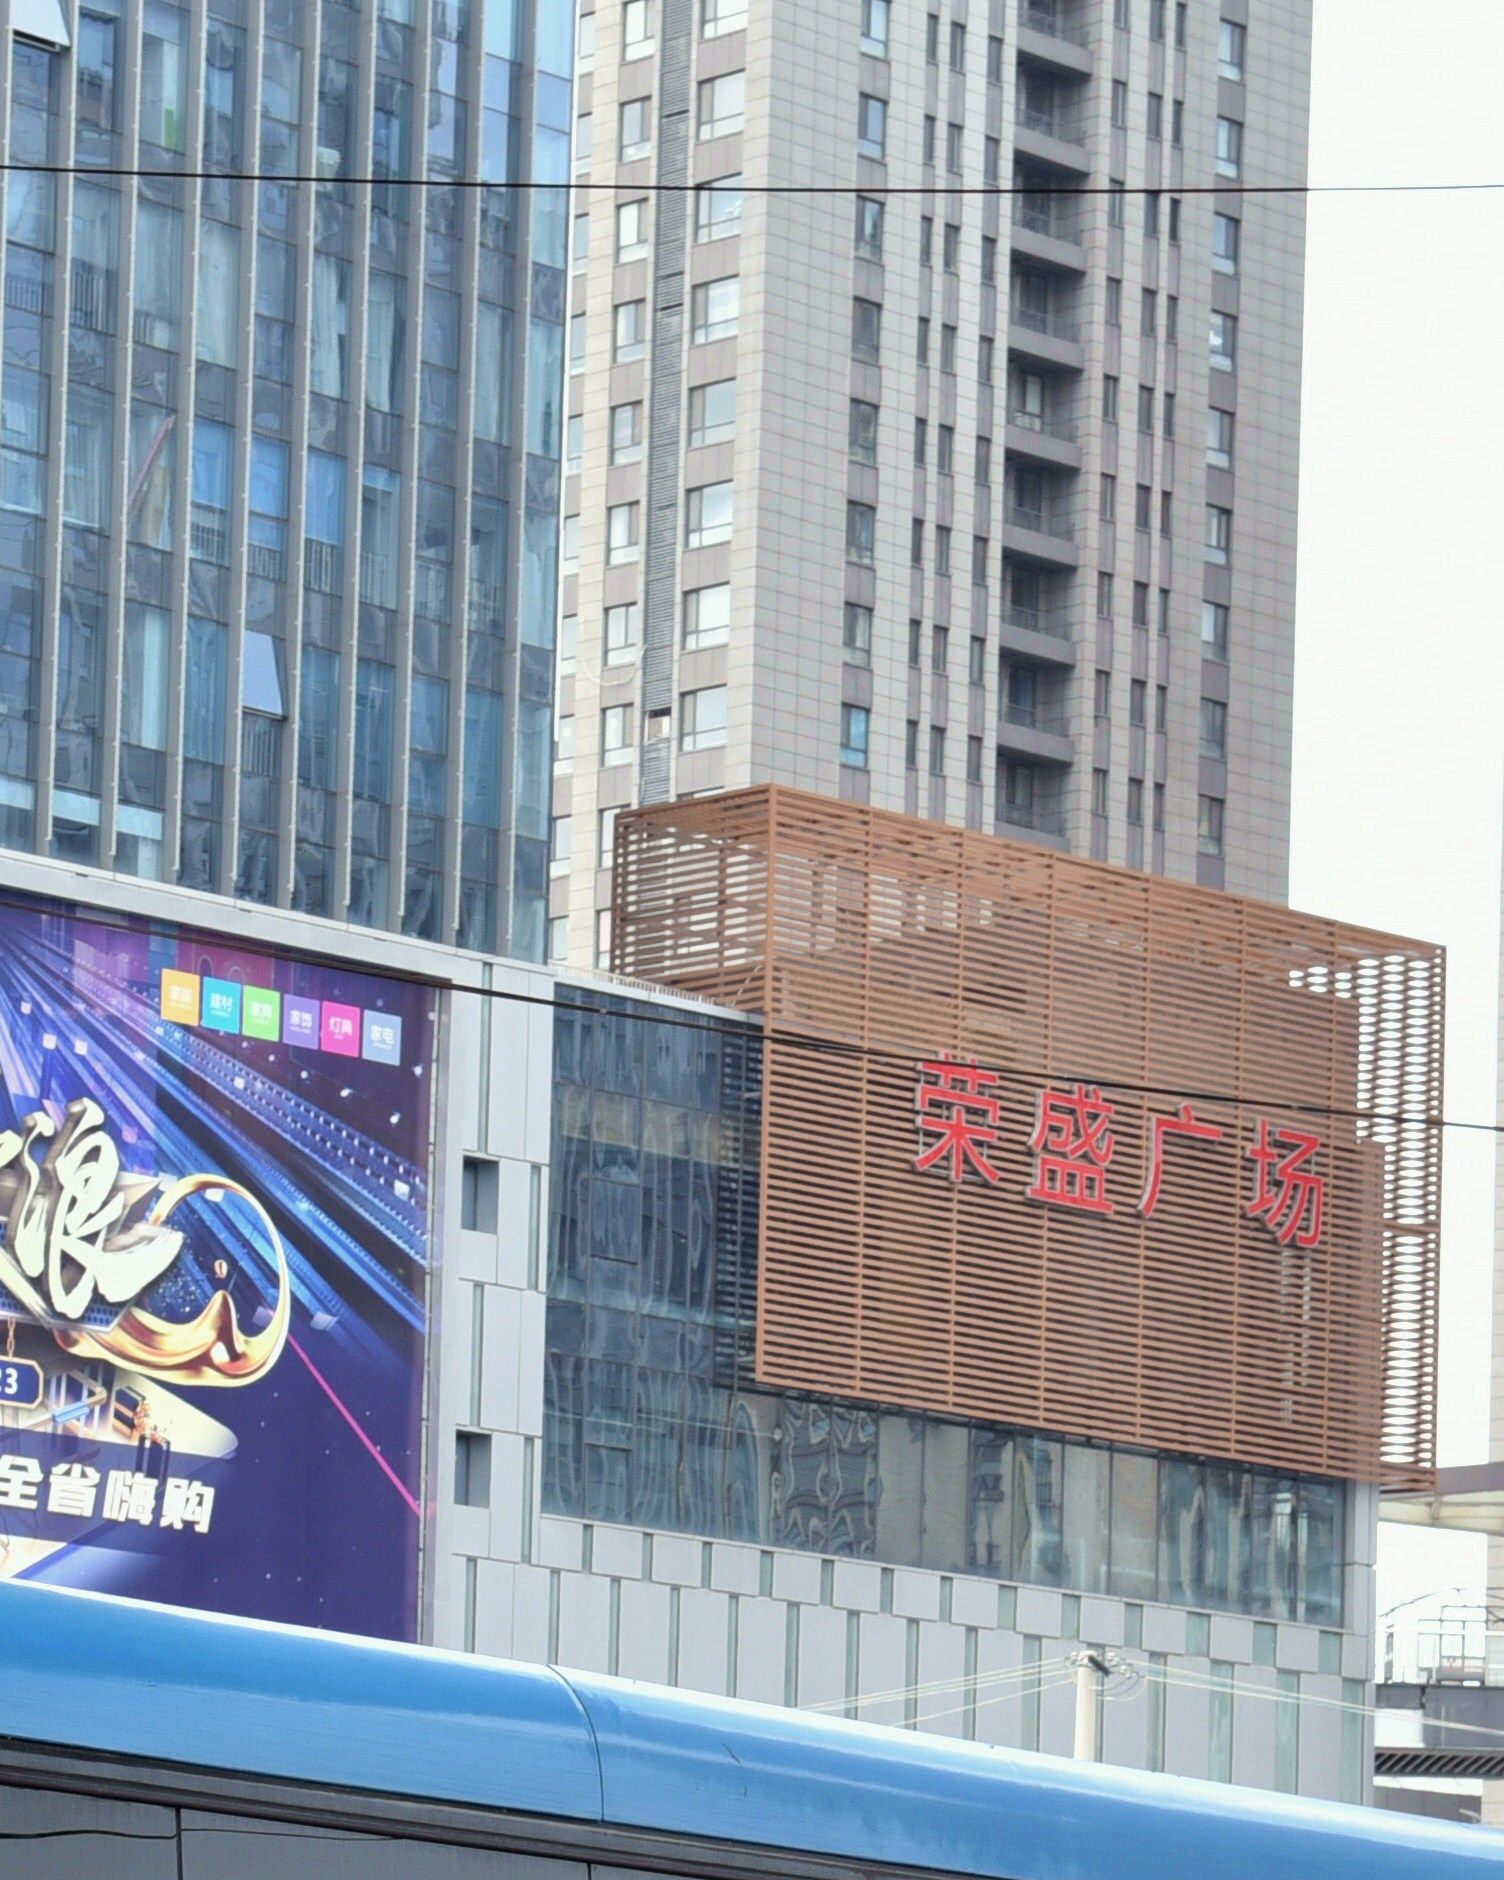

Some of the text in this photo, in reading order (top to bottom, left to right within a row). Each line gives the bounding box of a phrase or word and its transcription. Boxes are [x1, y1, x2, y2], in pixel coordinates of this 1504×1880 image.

[329, 1016, 354, 1037] 灯具
[914, 1052, 1325, 1249] 荣盛广场
